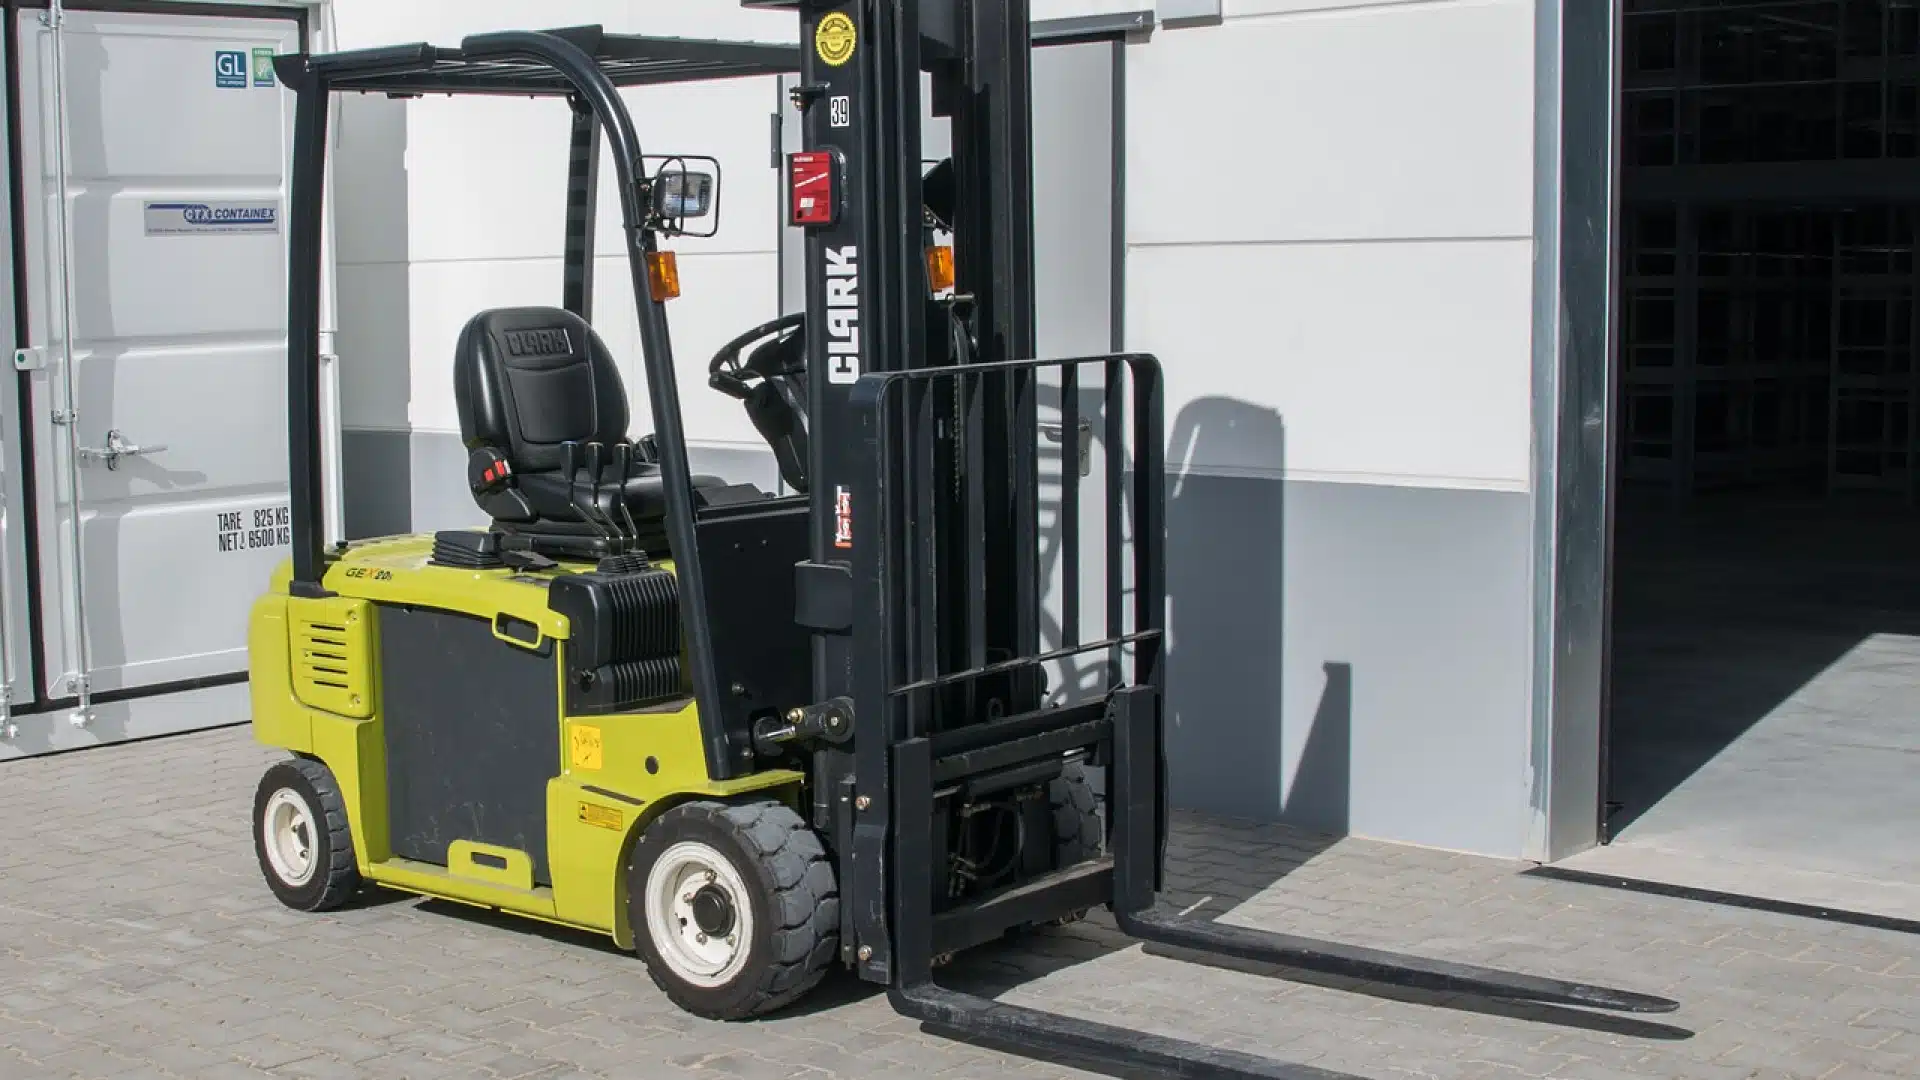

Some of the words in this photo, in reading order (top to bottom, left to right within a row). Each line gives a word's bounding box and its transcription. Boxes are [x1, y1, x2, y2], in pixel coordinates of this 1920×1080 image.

[217, 53, 245, 75] GL
[831, 98, 848, 125] 39
[214, 207, 275, 219] CONTAINEX
[825, 245, 859, 384] CLARK
[505, 328, 571, 355] CLARK
[217, 511, 242, 532] TARE
[254, 508, 274, 528] 825
[275, 506, 289, 526] KG
[248, 527, 275, 548] 6500
[276, 526, 290, 546] KG
